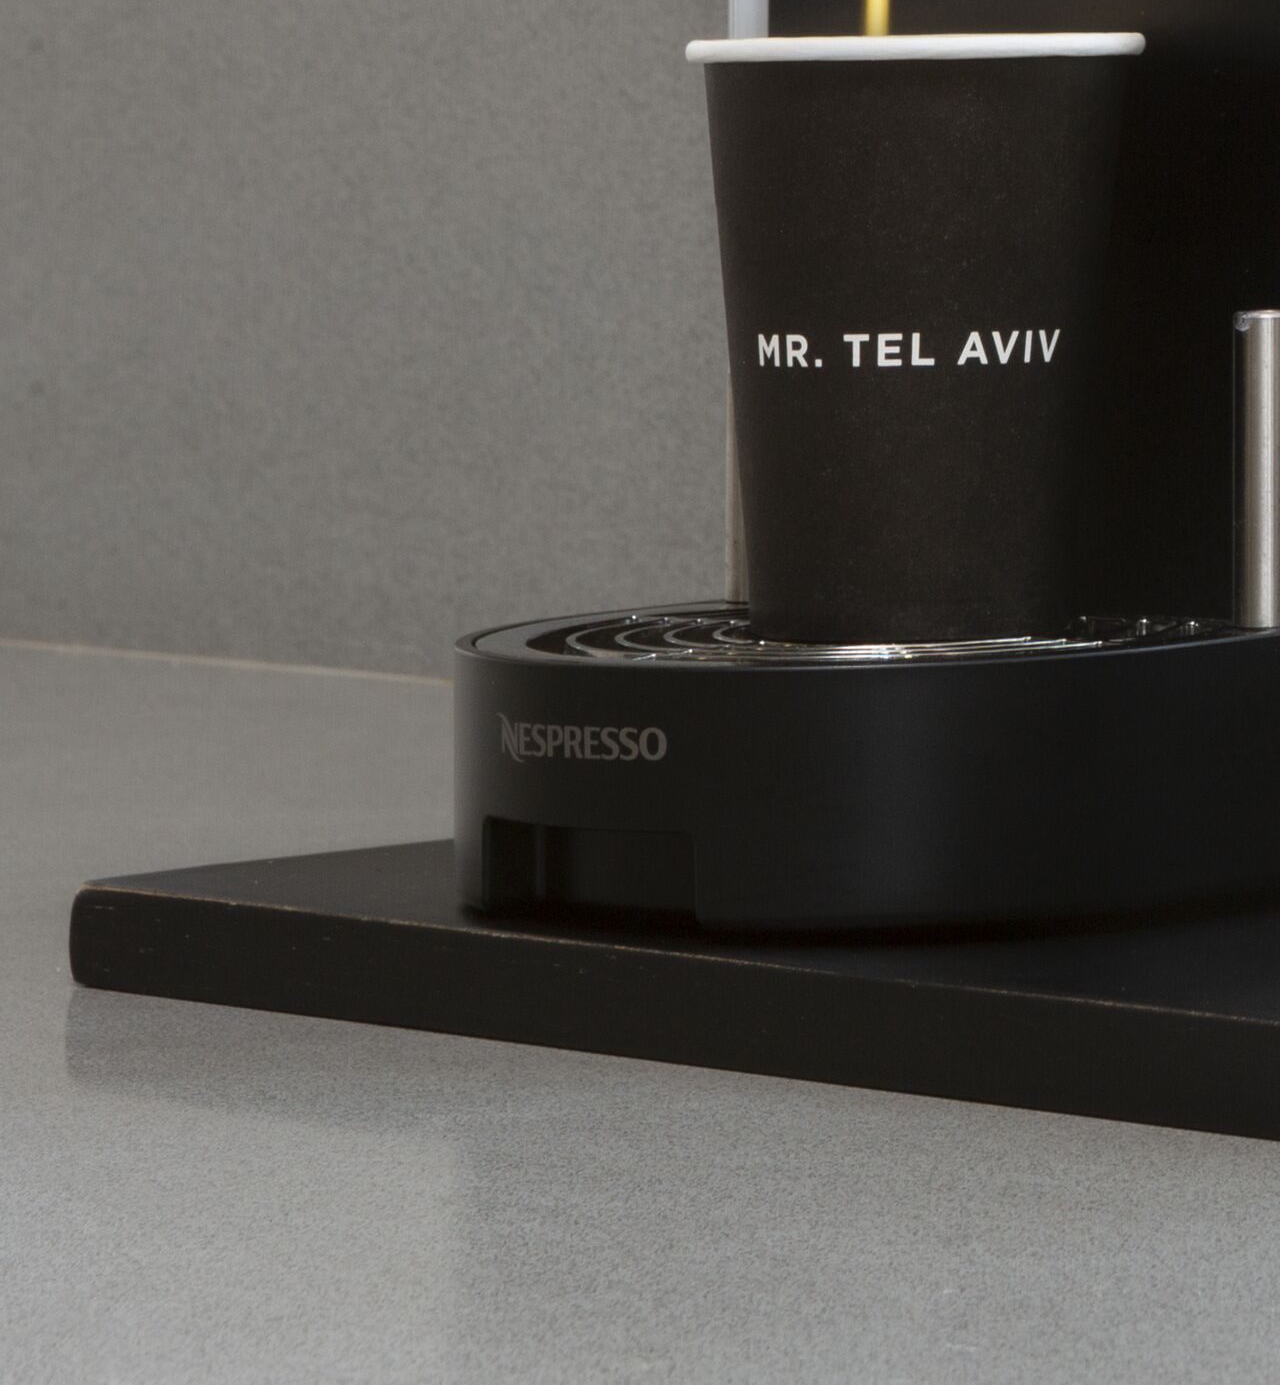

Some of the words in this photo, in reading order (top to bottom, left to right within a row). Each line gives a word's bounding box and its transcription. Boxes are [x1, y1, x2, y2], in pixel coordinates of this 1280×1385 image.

[757, 333, 823, 368] MR.
[843, 332, 936, 367] TEL
[957, 328, 1061, 365] AVIV
[497, 712, 668, 763] NESPRESSO
